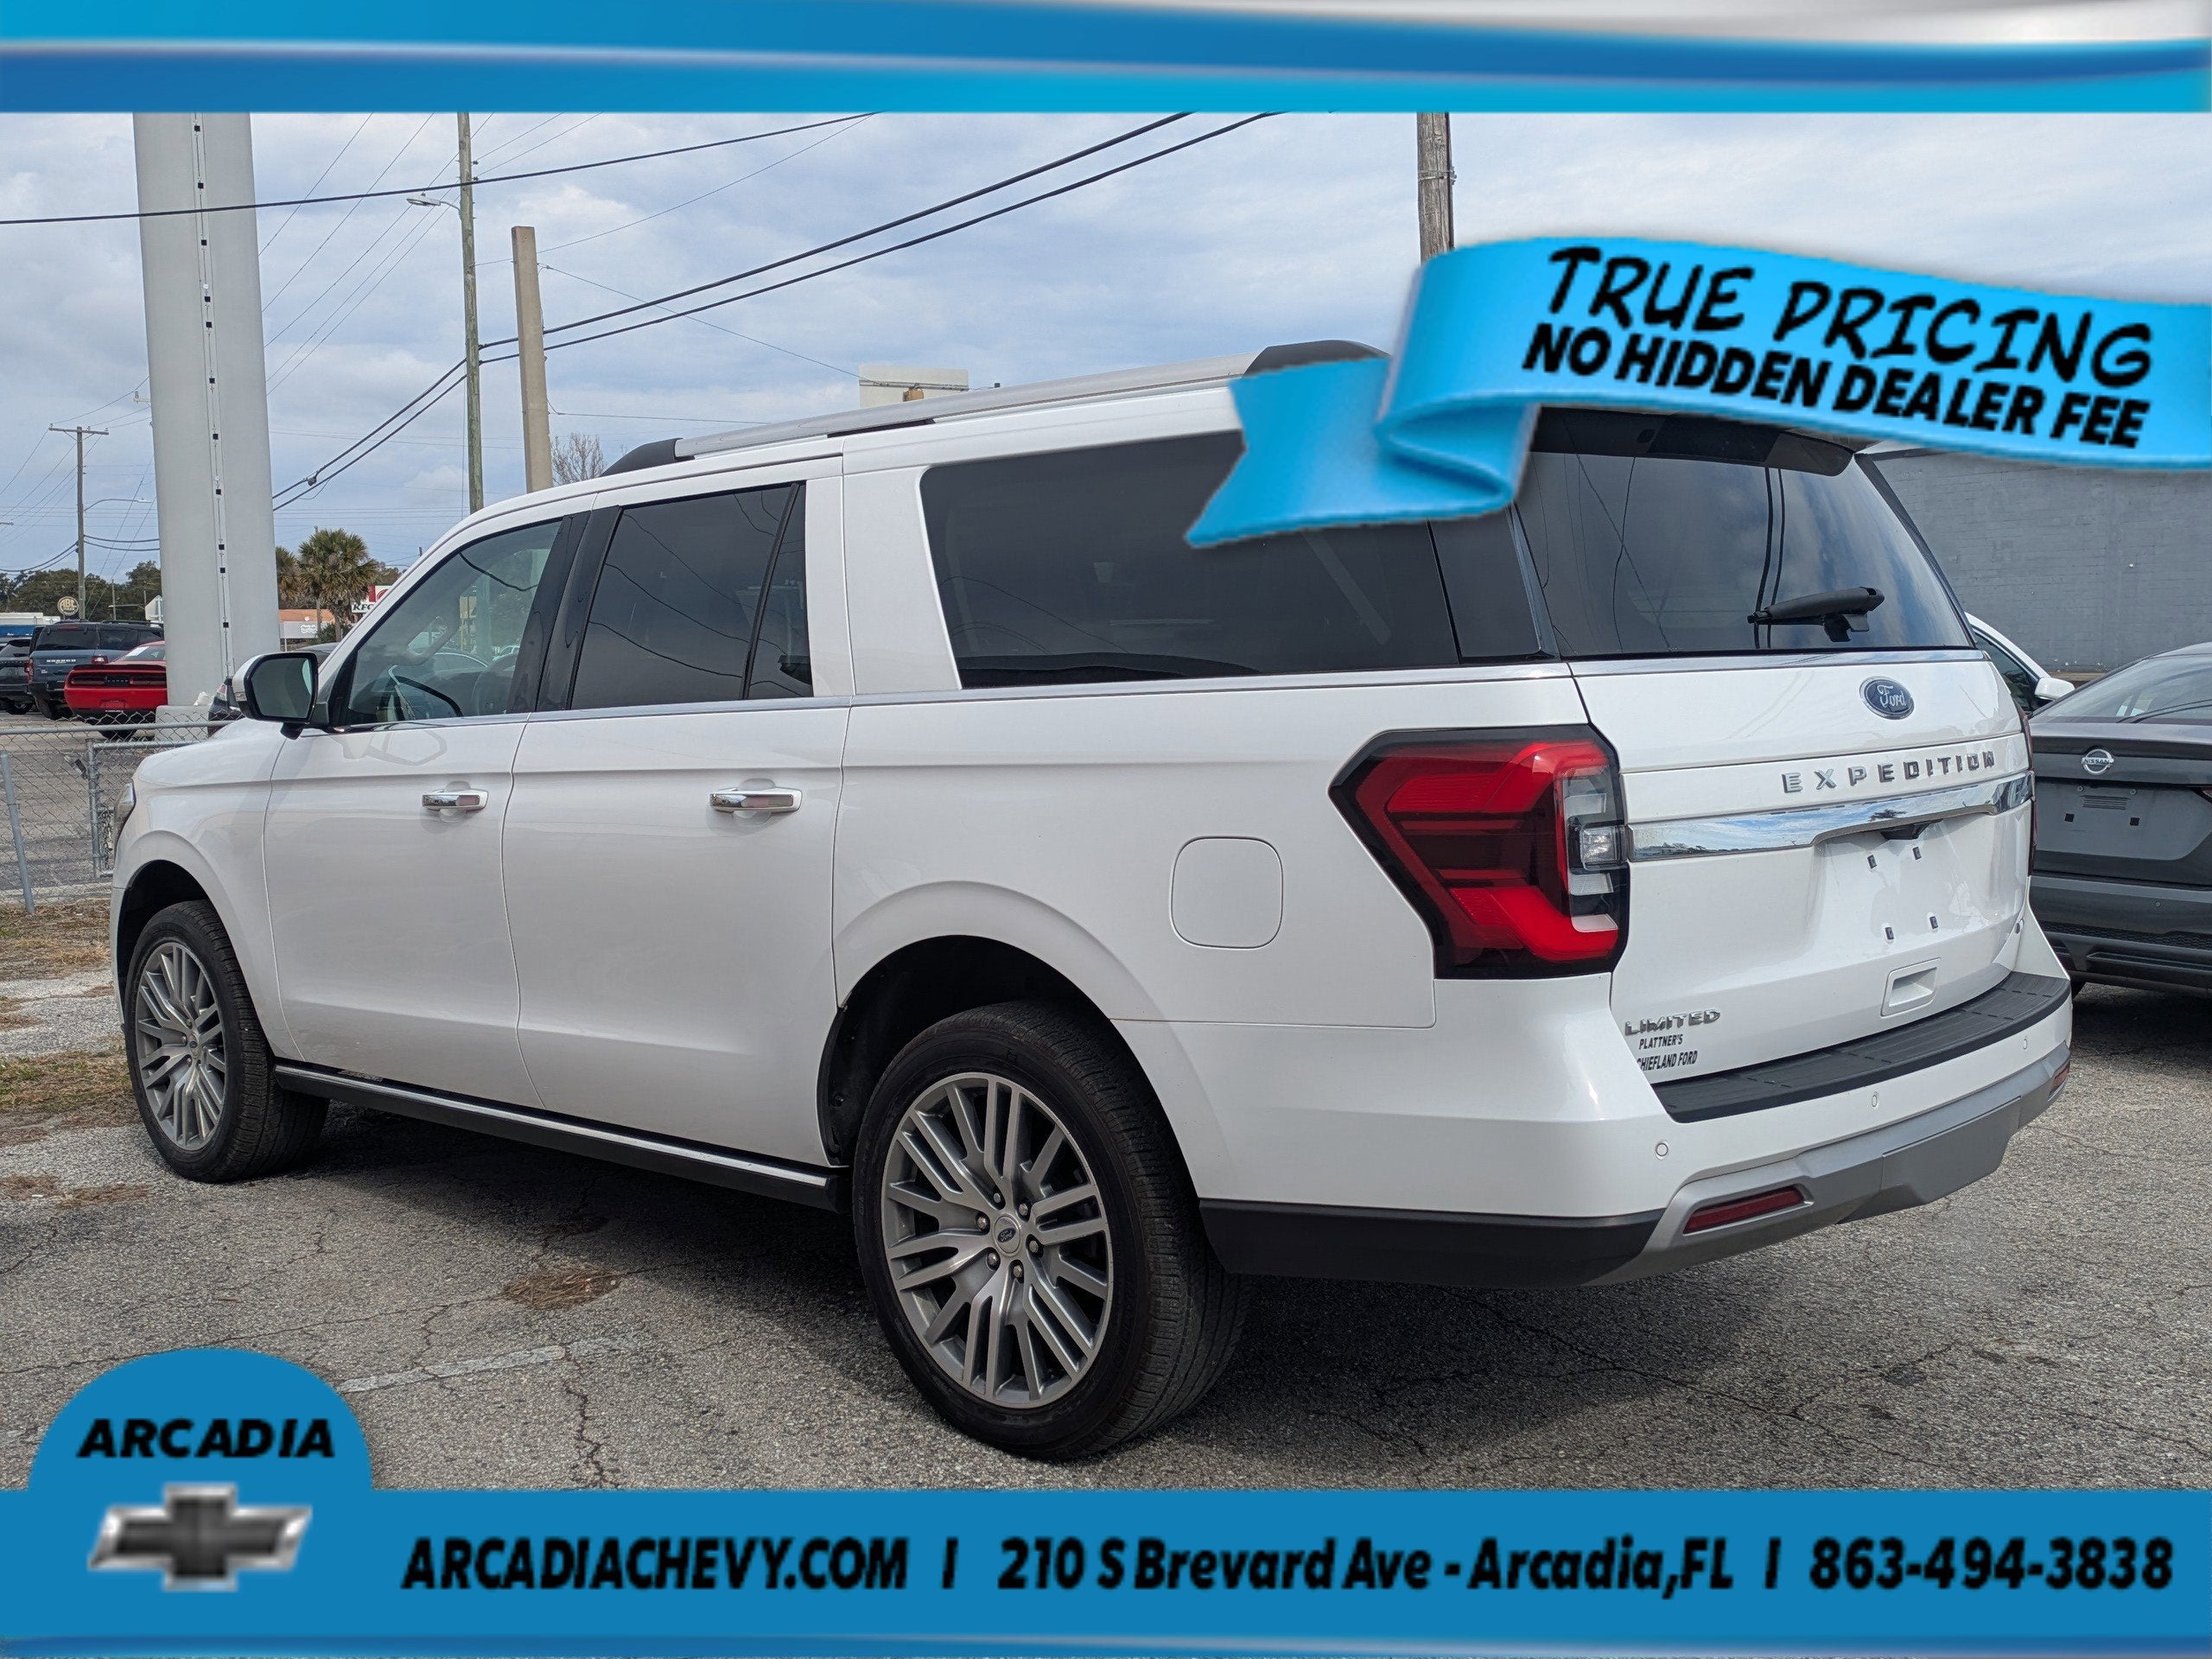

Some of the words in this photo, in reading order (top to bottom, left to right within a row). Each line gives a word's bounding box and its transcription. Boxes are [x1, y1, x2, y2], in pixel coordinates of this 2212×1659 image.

[1877, 683, 1906, 708] Ford
[1781, 750, 1995, 793] EXPEDITION
[1624, 1008, 1721, 1036] LIMITED
[1638, 1033, 1684, 1050] PLATTNER'S
[1677, 1050, 1698, 1067] FORD
